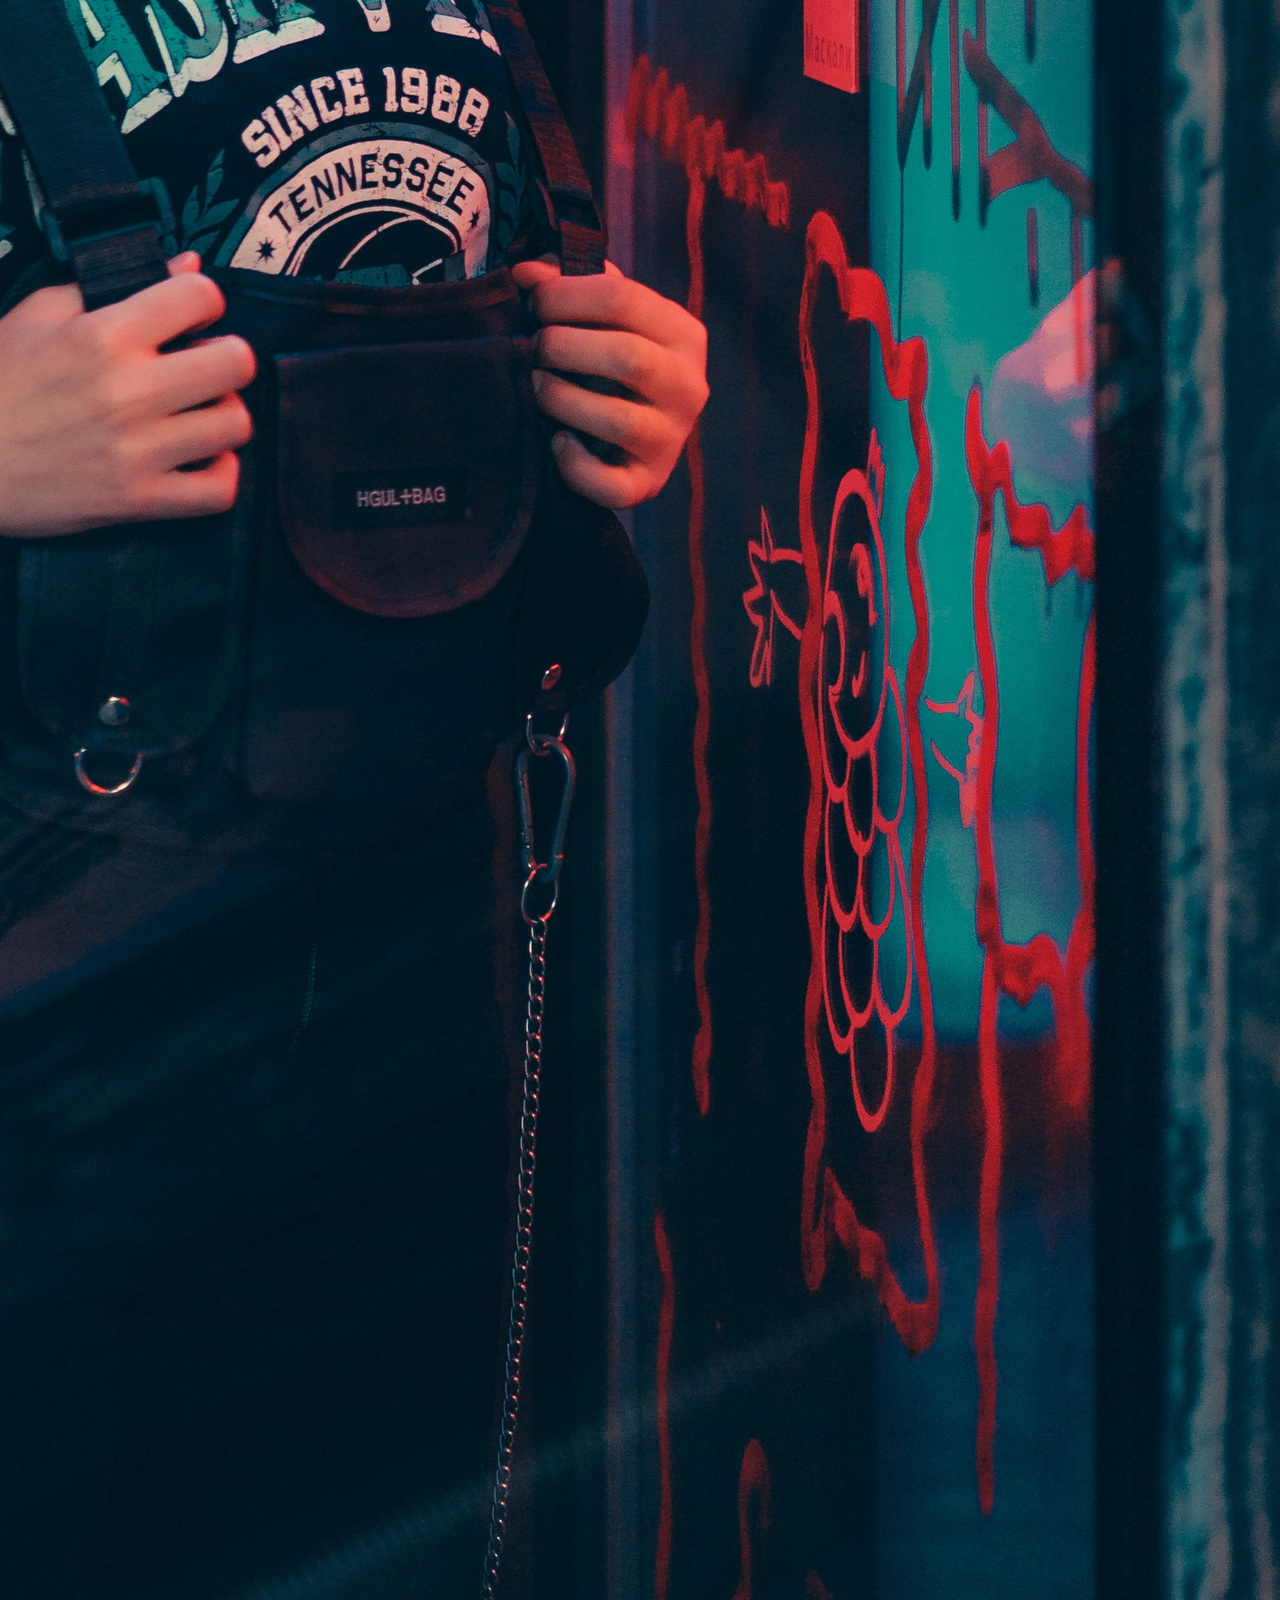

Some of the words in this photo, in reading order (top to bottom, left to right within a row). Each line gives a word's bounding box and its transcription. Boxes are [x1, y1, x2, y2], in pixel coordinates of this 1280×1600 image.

[241, 67, 370, 169] SINCE
[382, 66, 490, 138] 1988
[268, 153, 475, 234] TENNESSEE
[356, 486, 446, 508] HGUL+BAG
